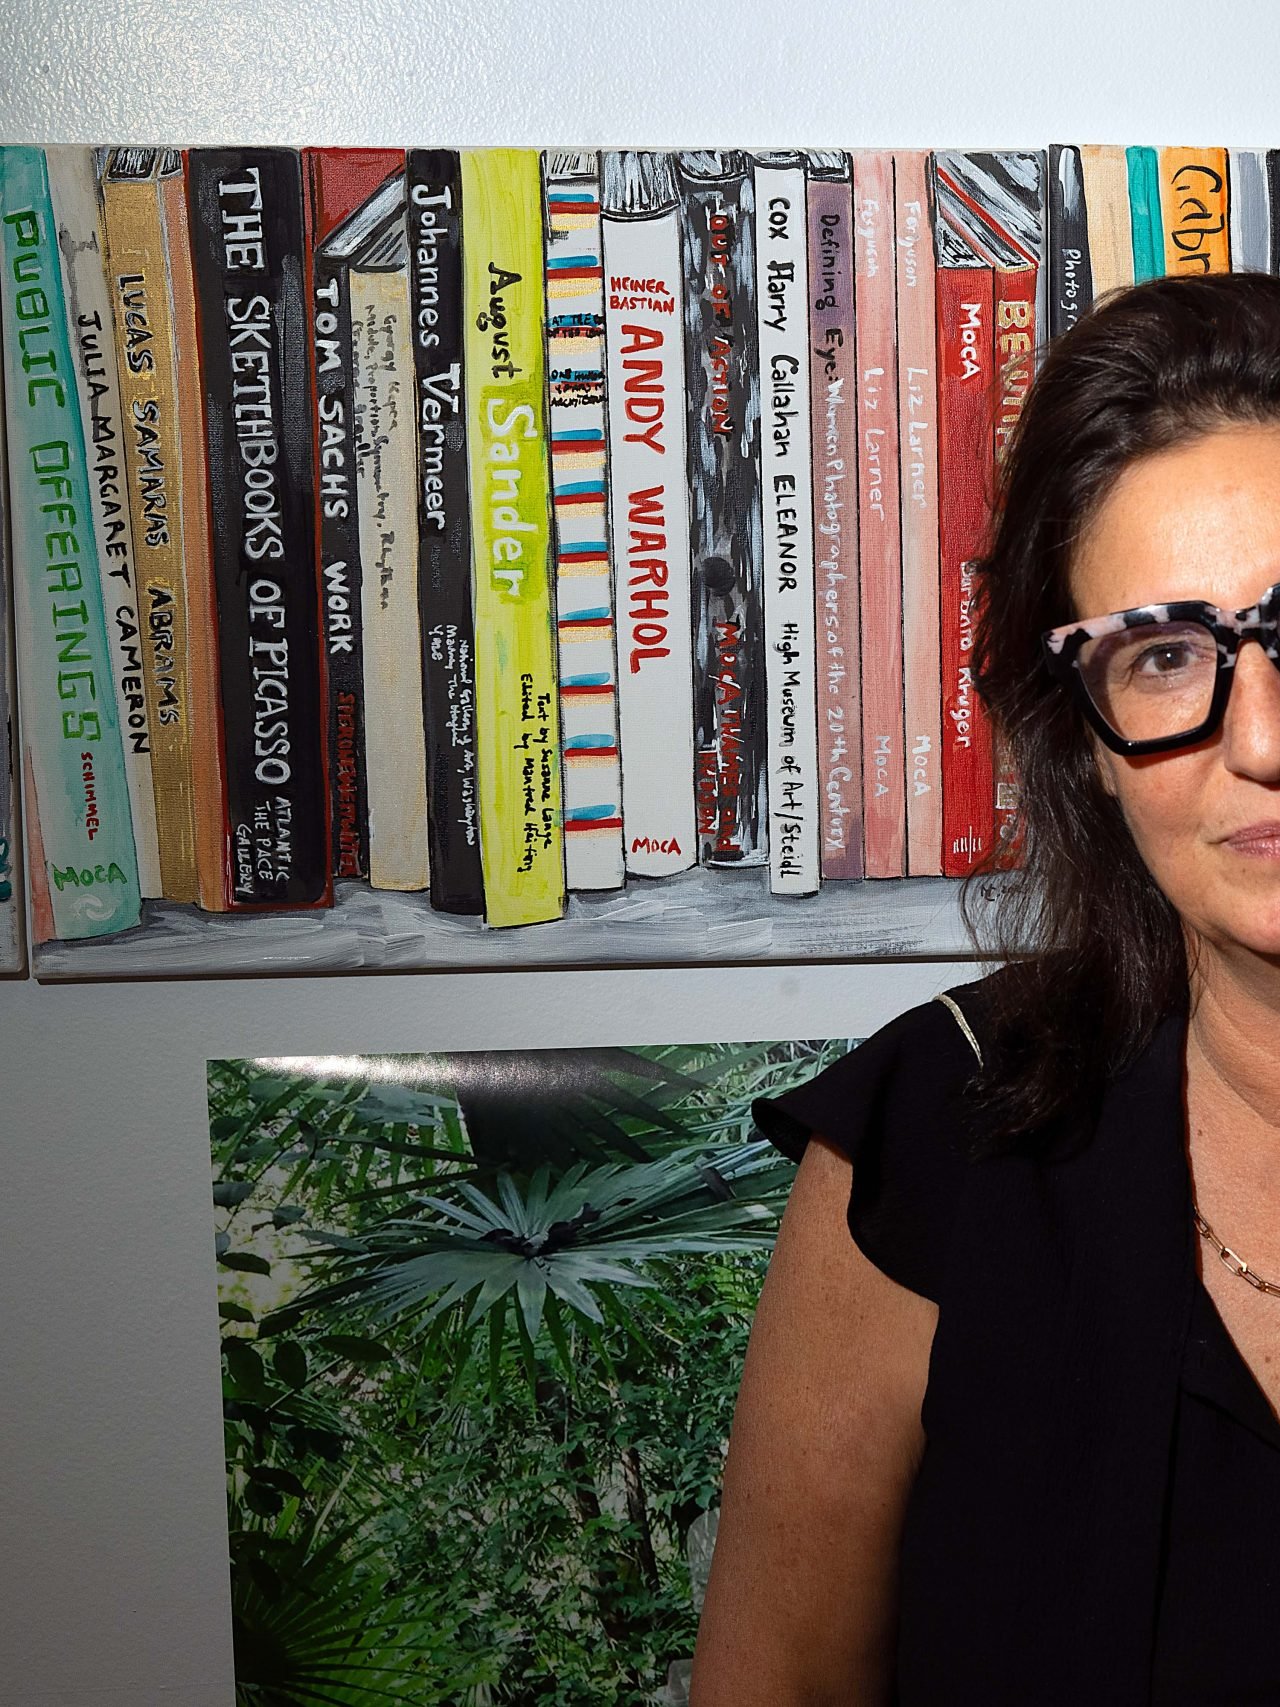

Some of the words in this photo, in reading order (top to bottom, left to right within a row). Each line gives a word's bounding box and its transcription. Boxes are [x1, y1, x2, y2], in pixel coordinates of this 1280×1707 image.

[218, 166, 265, 273] THE
[409, 183, 453, 347] Johannes
[814, 213, 842, 311] Defining
[3, 206, 66, 409] PUBLIC
[116, 273, 155, 375] LUCAS
[315, 277, 343, 373] TOM
[476, 261, 523, 380] August
[609, 294, 676, 316] BASTIAN
[610, 276, 671, 296] HEINER
[763, 260, 795, 332] Harry
[77, 310, 110, 403] JULIA
[709, 337, 733, 435] ACTION
[863, 367, 885, 411] Liz
[958, 303, 983, 380] MOCA
[226, 294, 286, 562] SKETCHBOOKS
[619, 323, 667, 456] ANDY
[769, 354, 800, 457] Callahan
[130, 399, 170, 548] SAMARAS
[317, 394, 350, 520] SACHS
[422, 362, 461, 531] Vermeer
[864, 428, 886, 522] Larner
[908, 421, 930, 509] Larner
[89, 416, 131, 589] MARGARET
[488, 397, 540, 597] Sander
[772, 474, 800, 594] ELEANOR
[29, 438, 101, 742] OFFERINGS
[248, 578, 286, 629] OF
[322, 560, 353, 655] WORK
[626, 484, 671, 674] WARHOL
[114, 605, 150, 754] CAMERON
[147, 585, 180, 727] ABRAMS
[772, 620, 800, 665] High
[249, 636, 292, 785] PICASSO
[513, 732, 533, 750] by
[532, 727, 550, 743] by
[777, 671, 801, 747] Museum
[950, 667, 976, 748] Kruger
[775, 755, 802, 775] of
[873, 734, 892, 797] MOCA
[912, 734, 932, 796] MOCA
[254, 801, 269, 831] THE
[259, 833, 275, 881] PACE
[274, 796, 293, 882] ATLANTIC
[631, 836, 682, 856] MOCA
